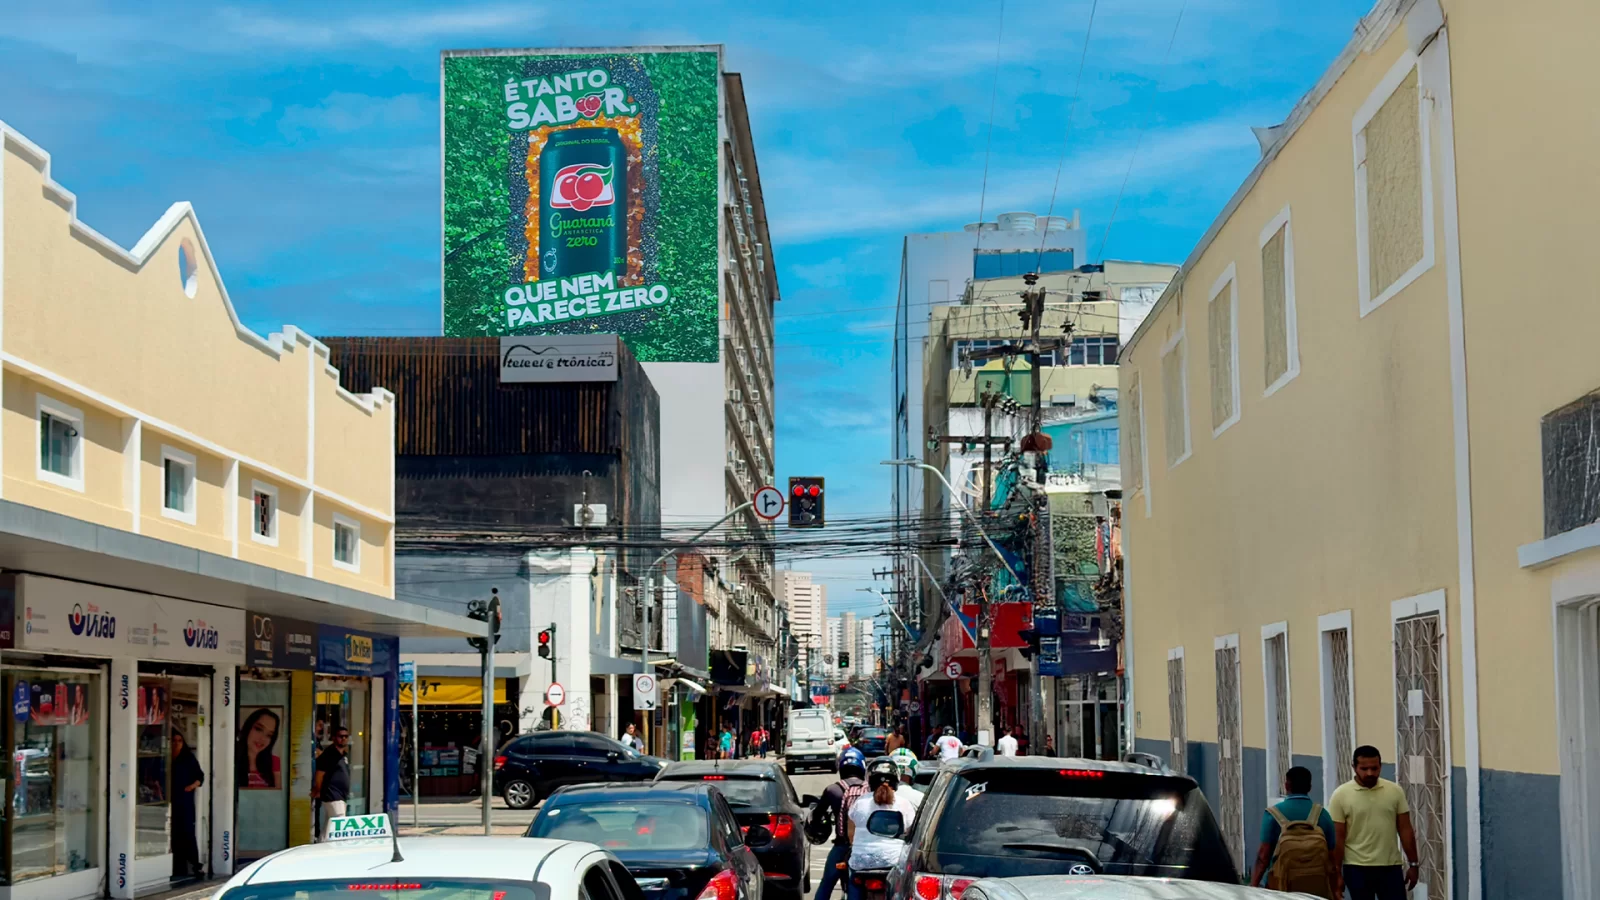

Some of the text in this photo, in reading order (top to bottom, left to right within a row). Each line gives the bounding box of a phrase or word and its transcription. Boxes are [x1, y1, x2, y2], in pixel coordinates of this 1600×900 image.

[504, 69, 608, 102] É TANTO
[549, 211, 615, 239] Guaraná
[566, 236, 598, 248] zero
[504, 271, 614, 307] QUE NEM
[506, 284, 670, 328] PARECE ZERO
[328, 827, 386, 838] FORTALEZA
[331, 815, 384, 831] TAXI
